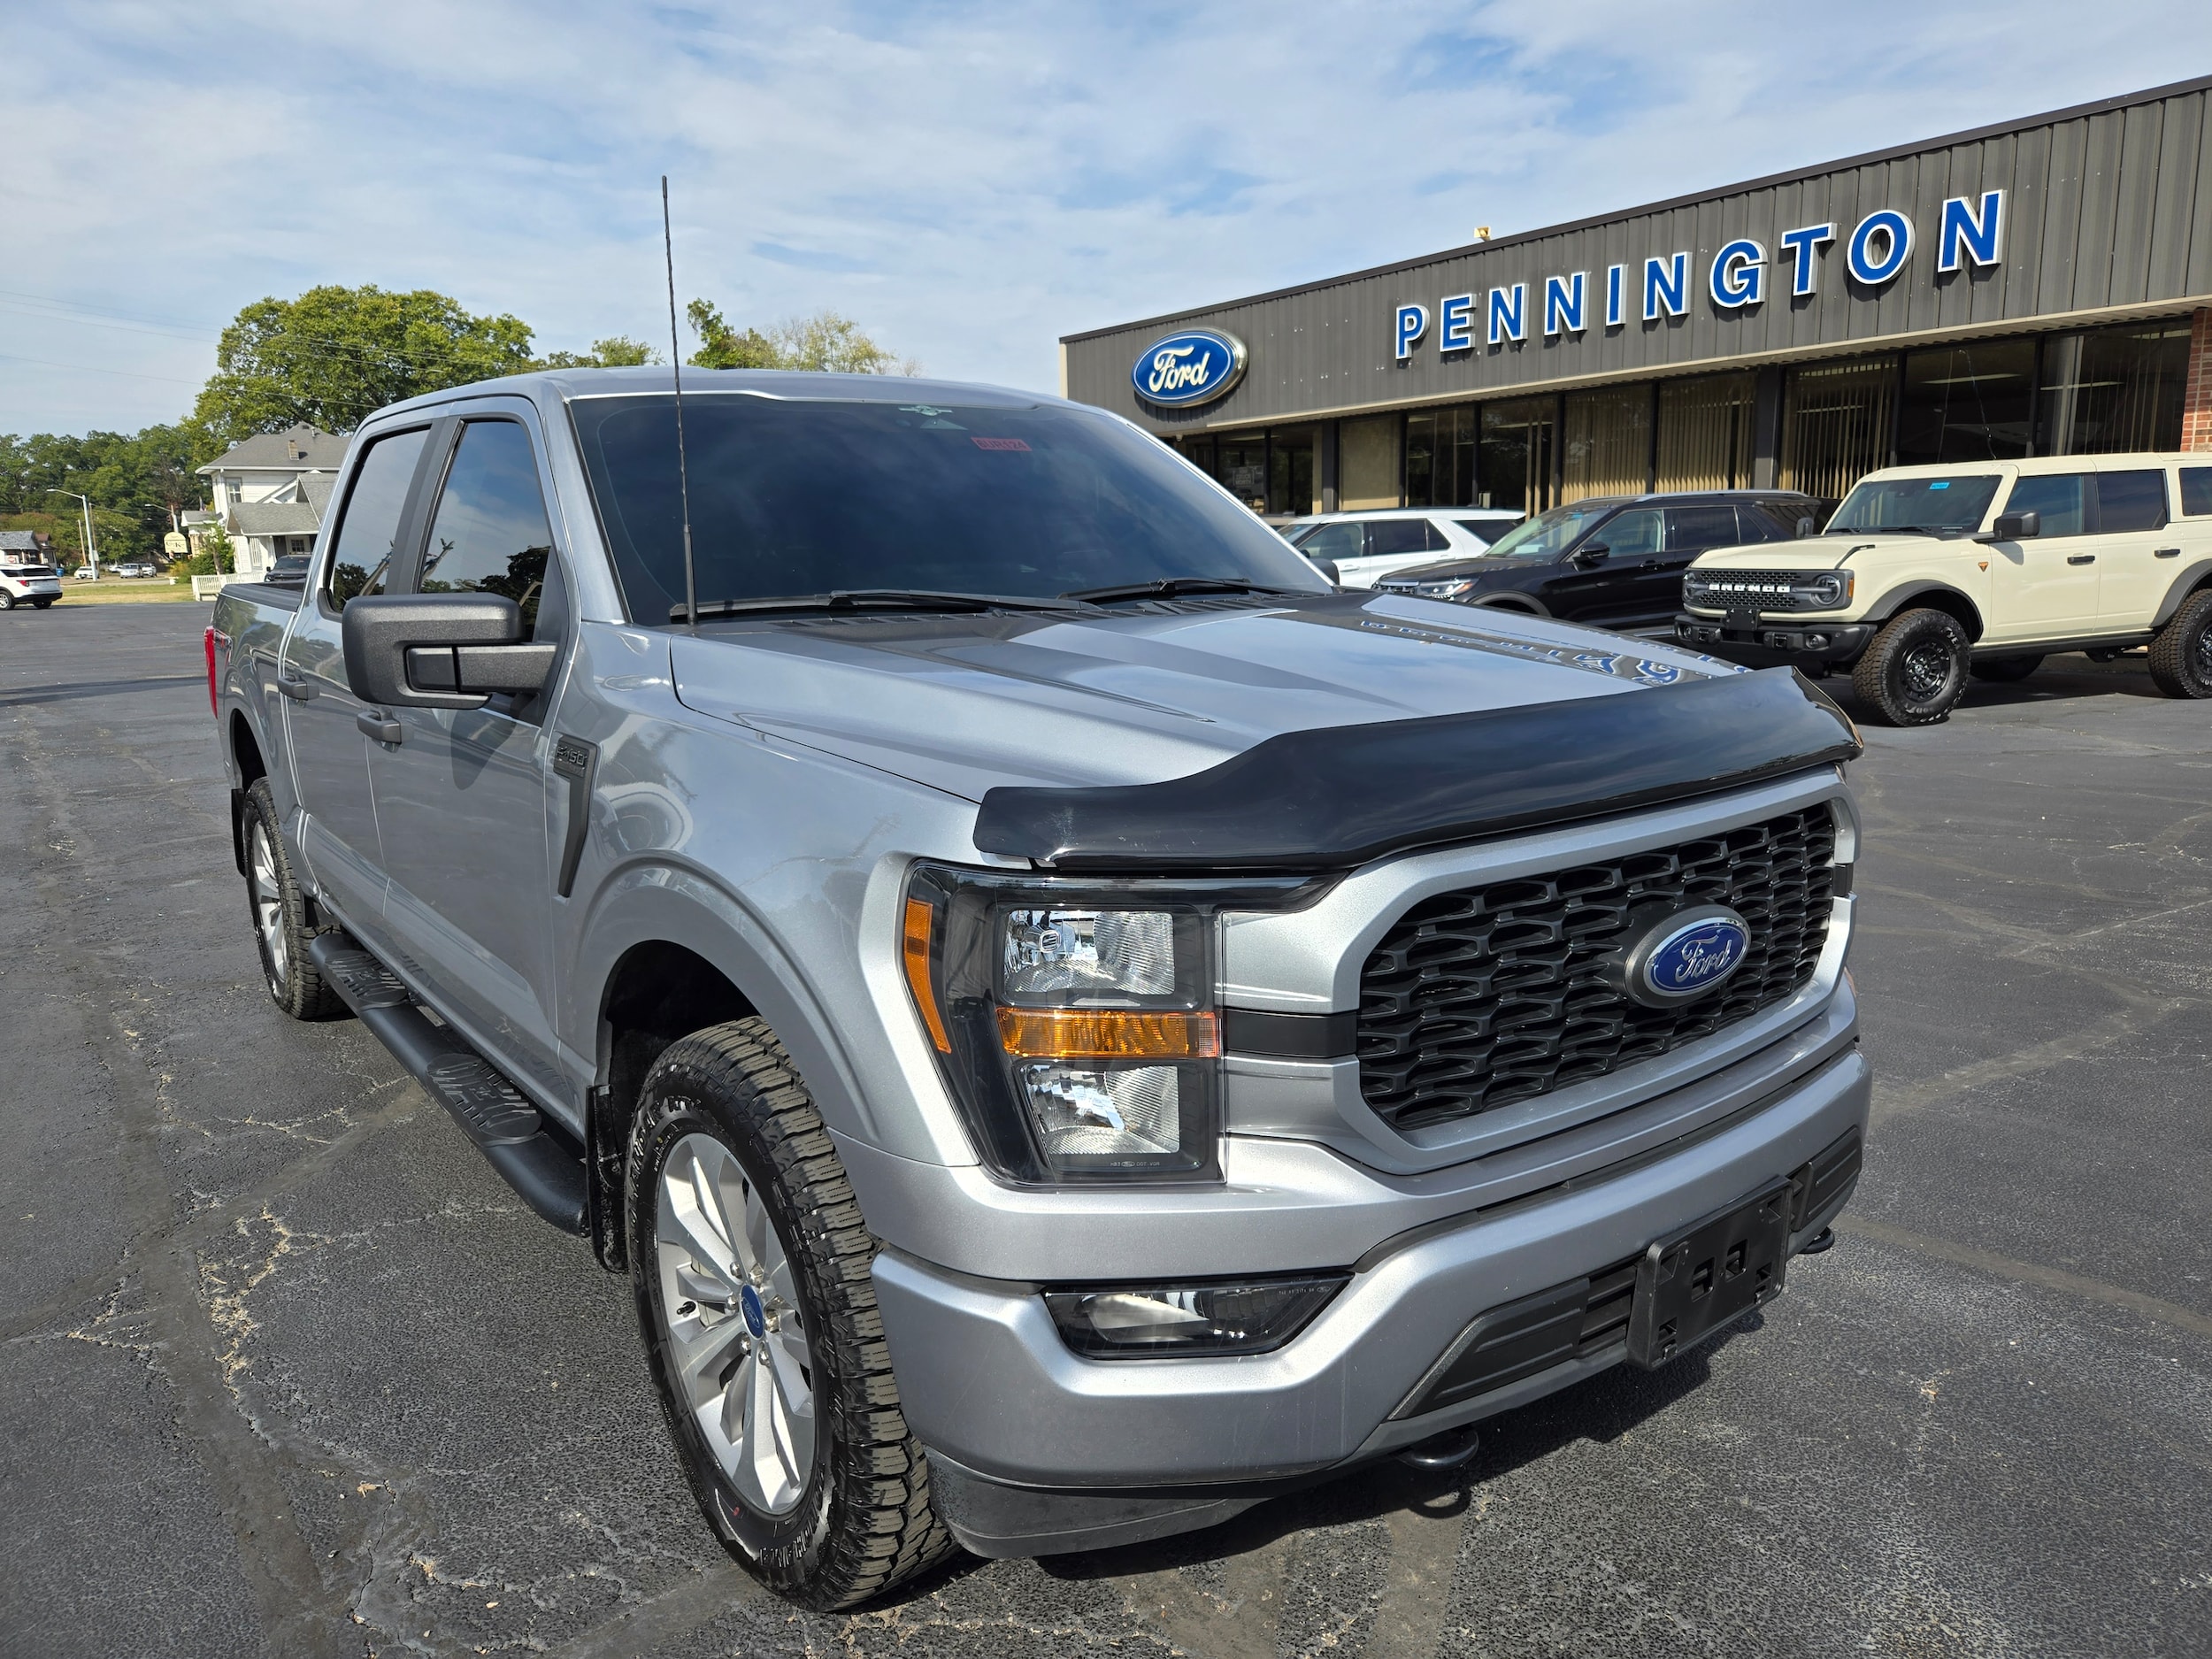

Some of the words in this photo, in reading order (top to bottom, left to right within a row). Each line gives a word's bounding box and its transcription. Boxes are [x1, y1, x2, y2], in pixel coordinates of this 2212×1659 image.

[1395, 189, 2007, 360] PENNINGTON
[1148, 344, 1210, 393] Ford
[1675, 934, 1732, 983] Ford
